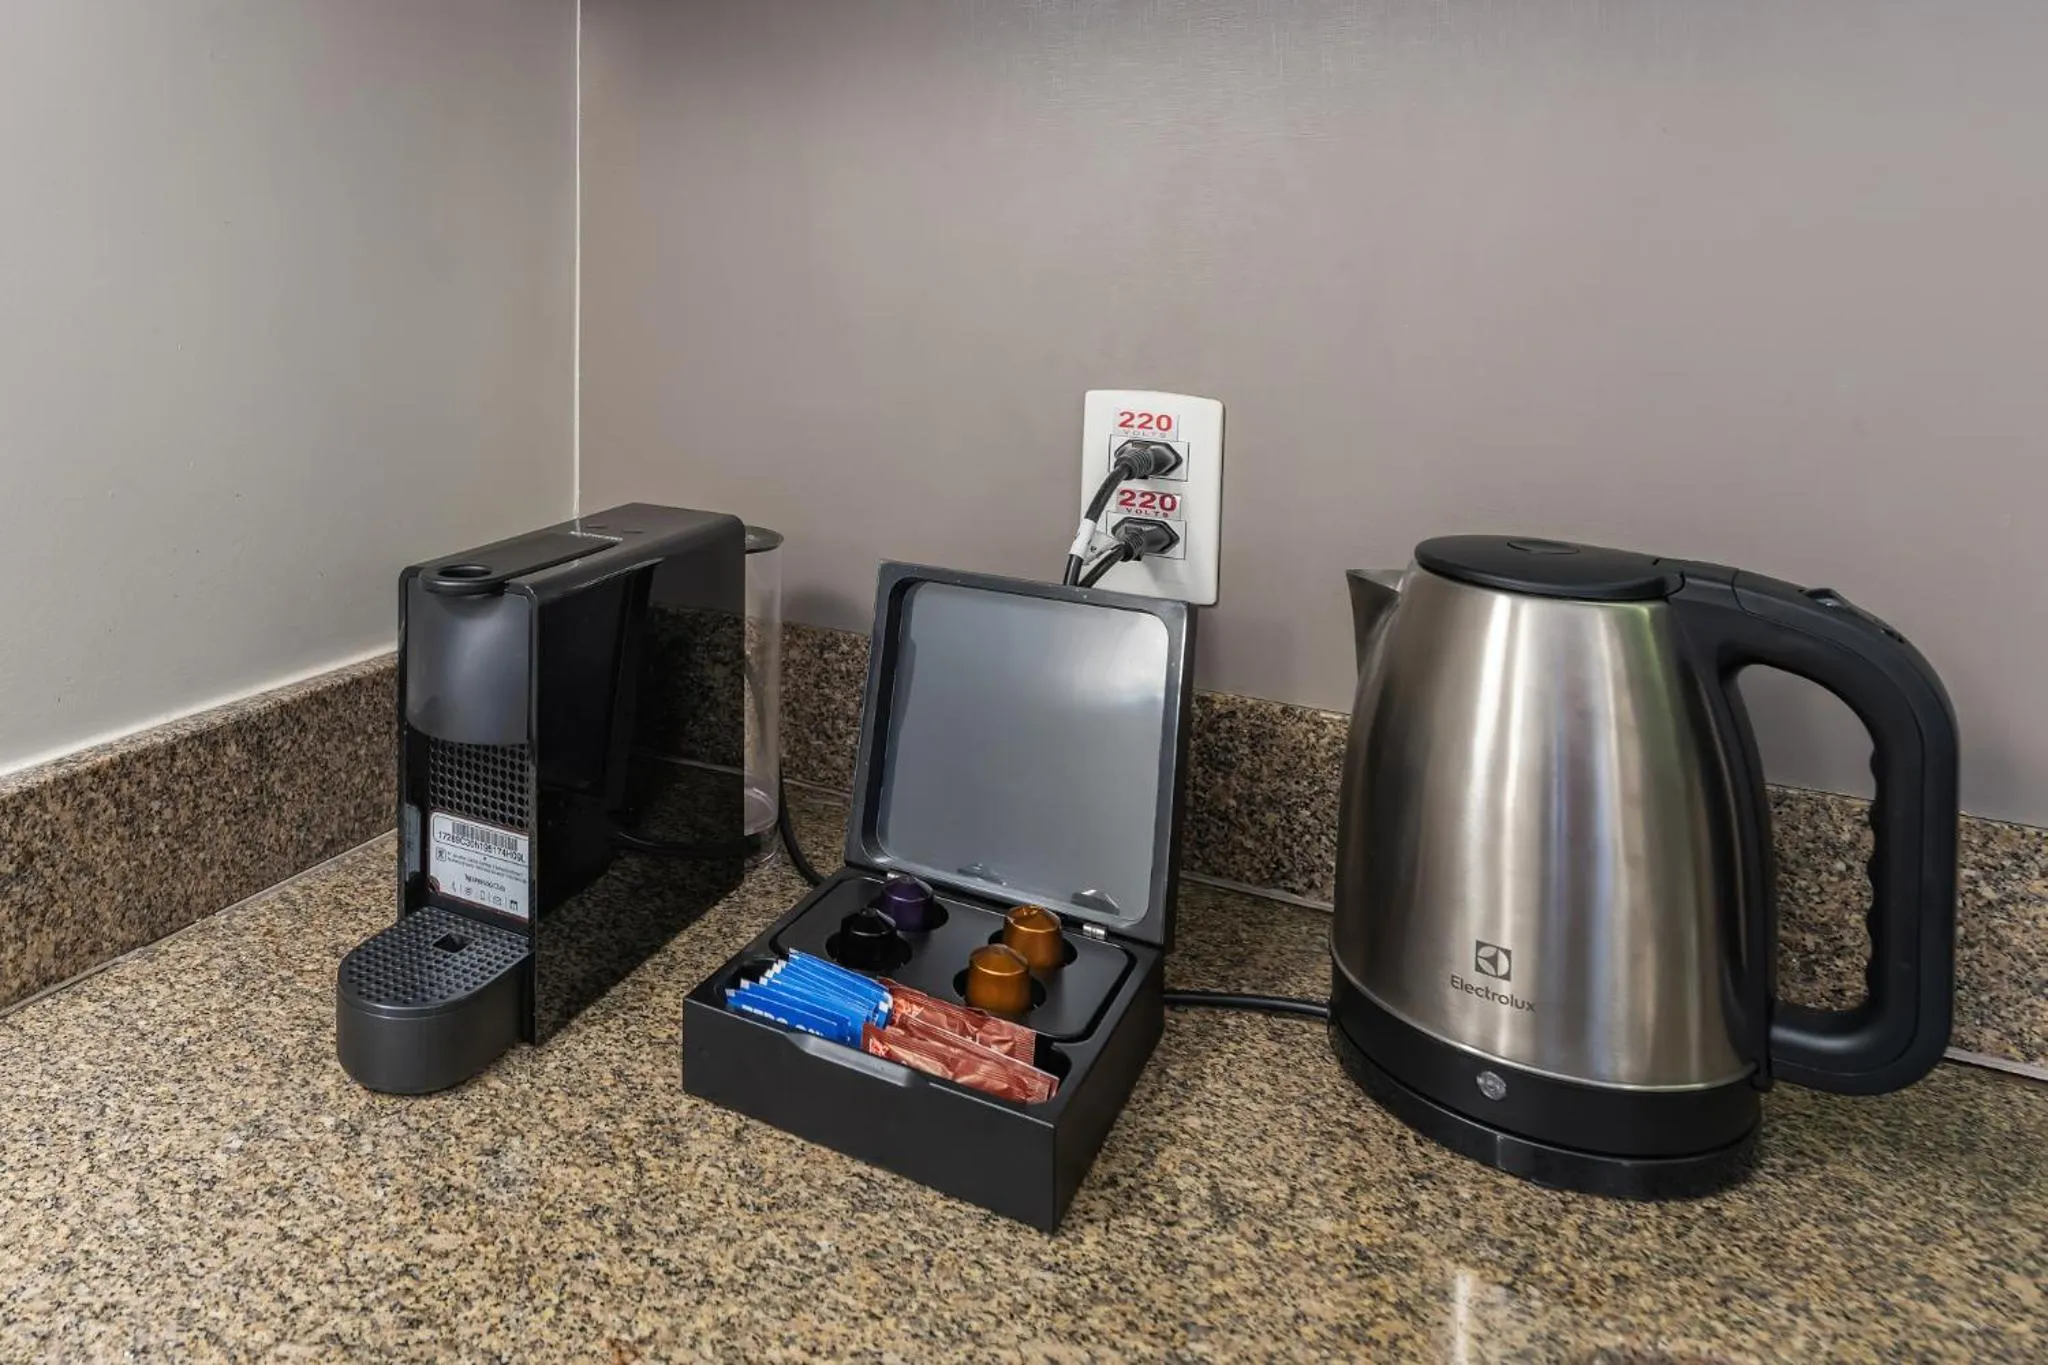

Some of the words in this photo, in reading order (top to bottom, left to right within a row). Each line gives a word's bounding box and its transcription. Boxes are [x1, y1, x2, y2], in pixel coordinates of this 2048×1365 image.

[1118, 411, 1173, 432] 220
[1123, 430, 1168, 439] VOLTS
[1118, 489, 1178, 512] 220
[1125, 508, 1169, 518] VOLTS
[1450, 974, 1537, 1013] Electrolux
